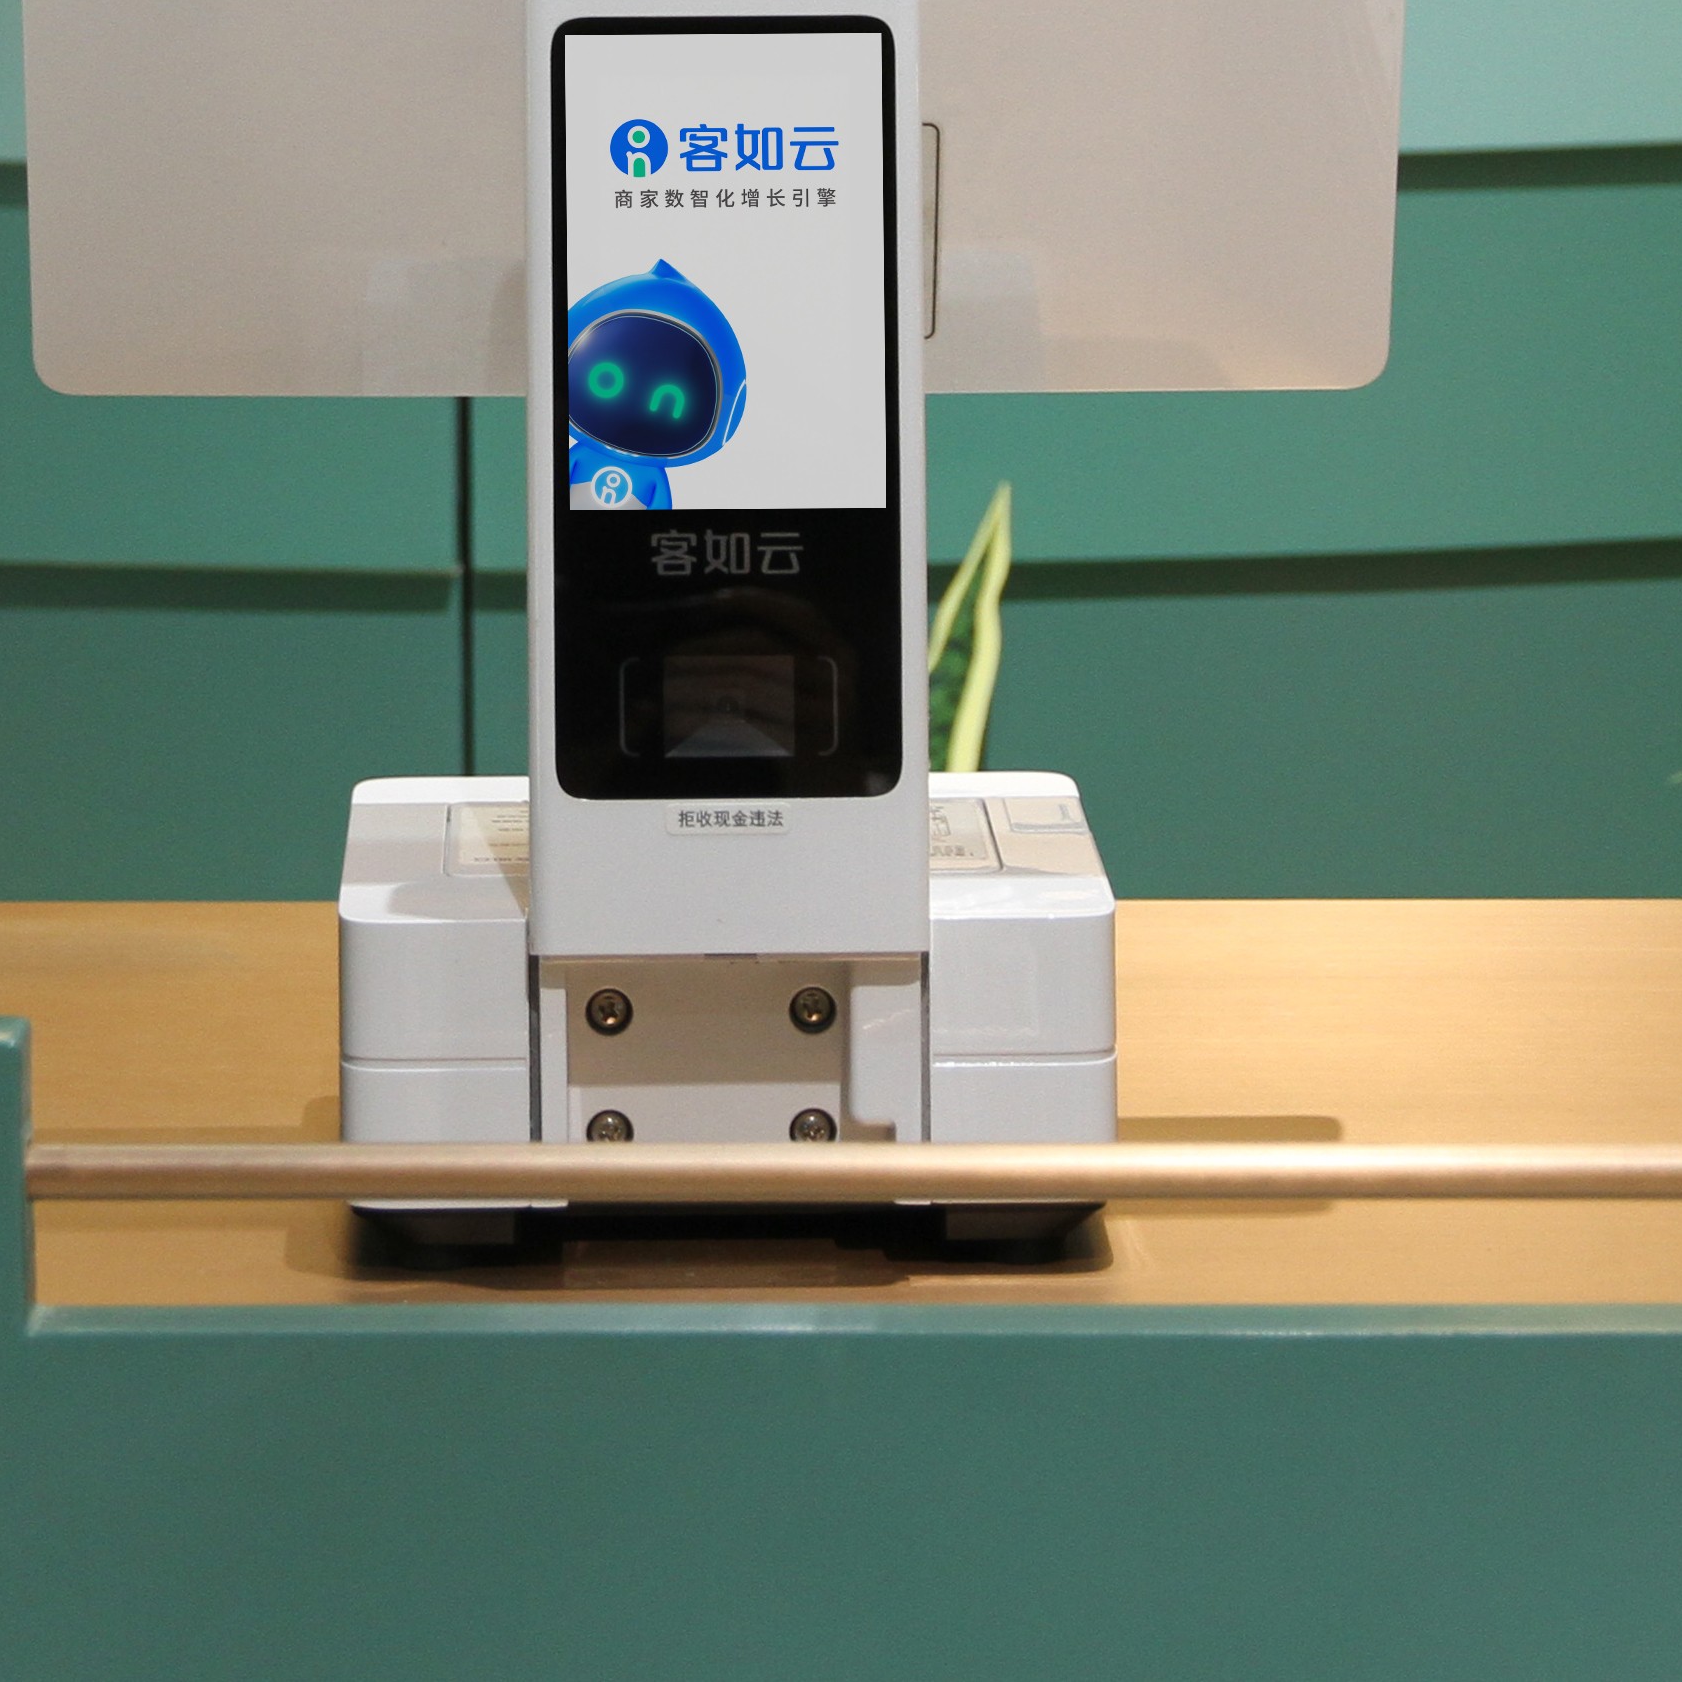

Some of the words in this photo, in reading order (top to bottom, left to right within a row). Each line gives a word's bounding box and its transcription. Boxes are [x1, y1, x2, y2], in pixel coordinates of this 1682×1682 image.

[679, 123, 840, 172] 客如云
[614, 188, 837, 209] 商家数智化增长引擎
[650, 529, 804, 576] 客如云
[678, 809, 785, 828] 拒收现金违法
